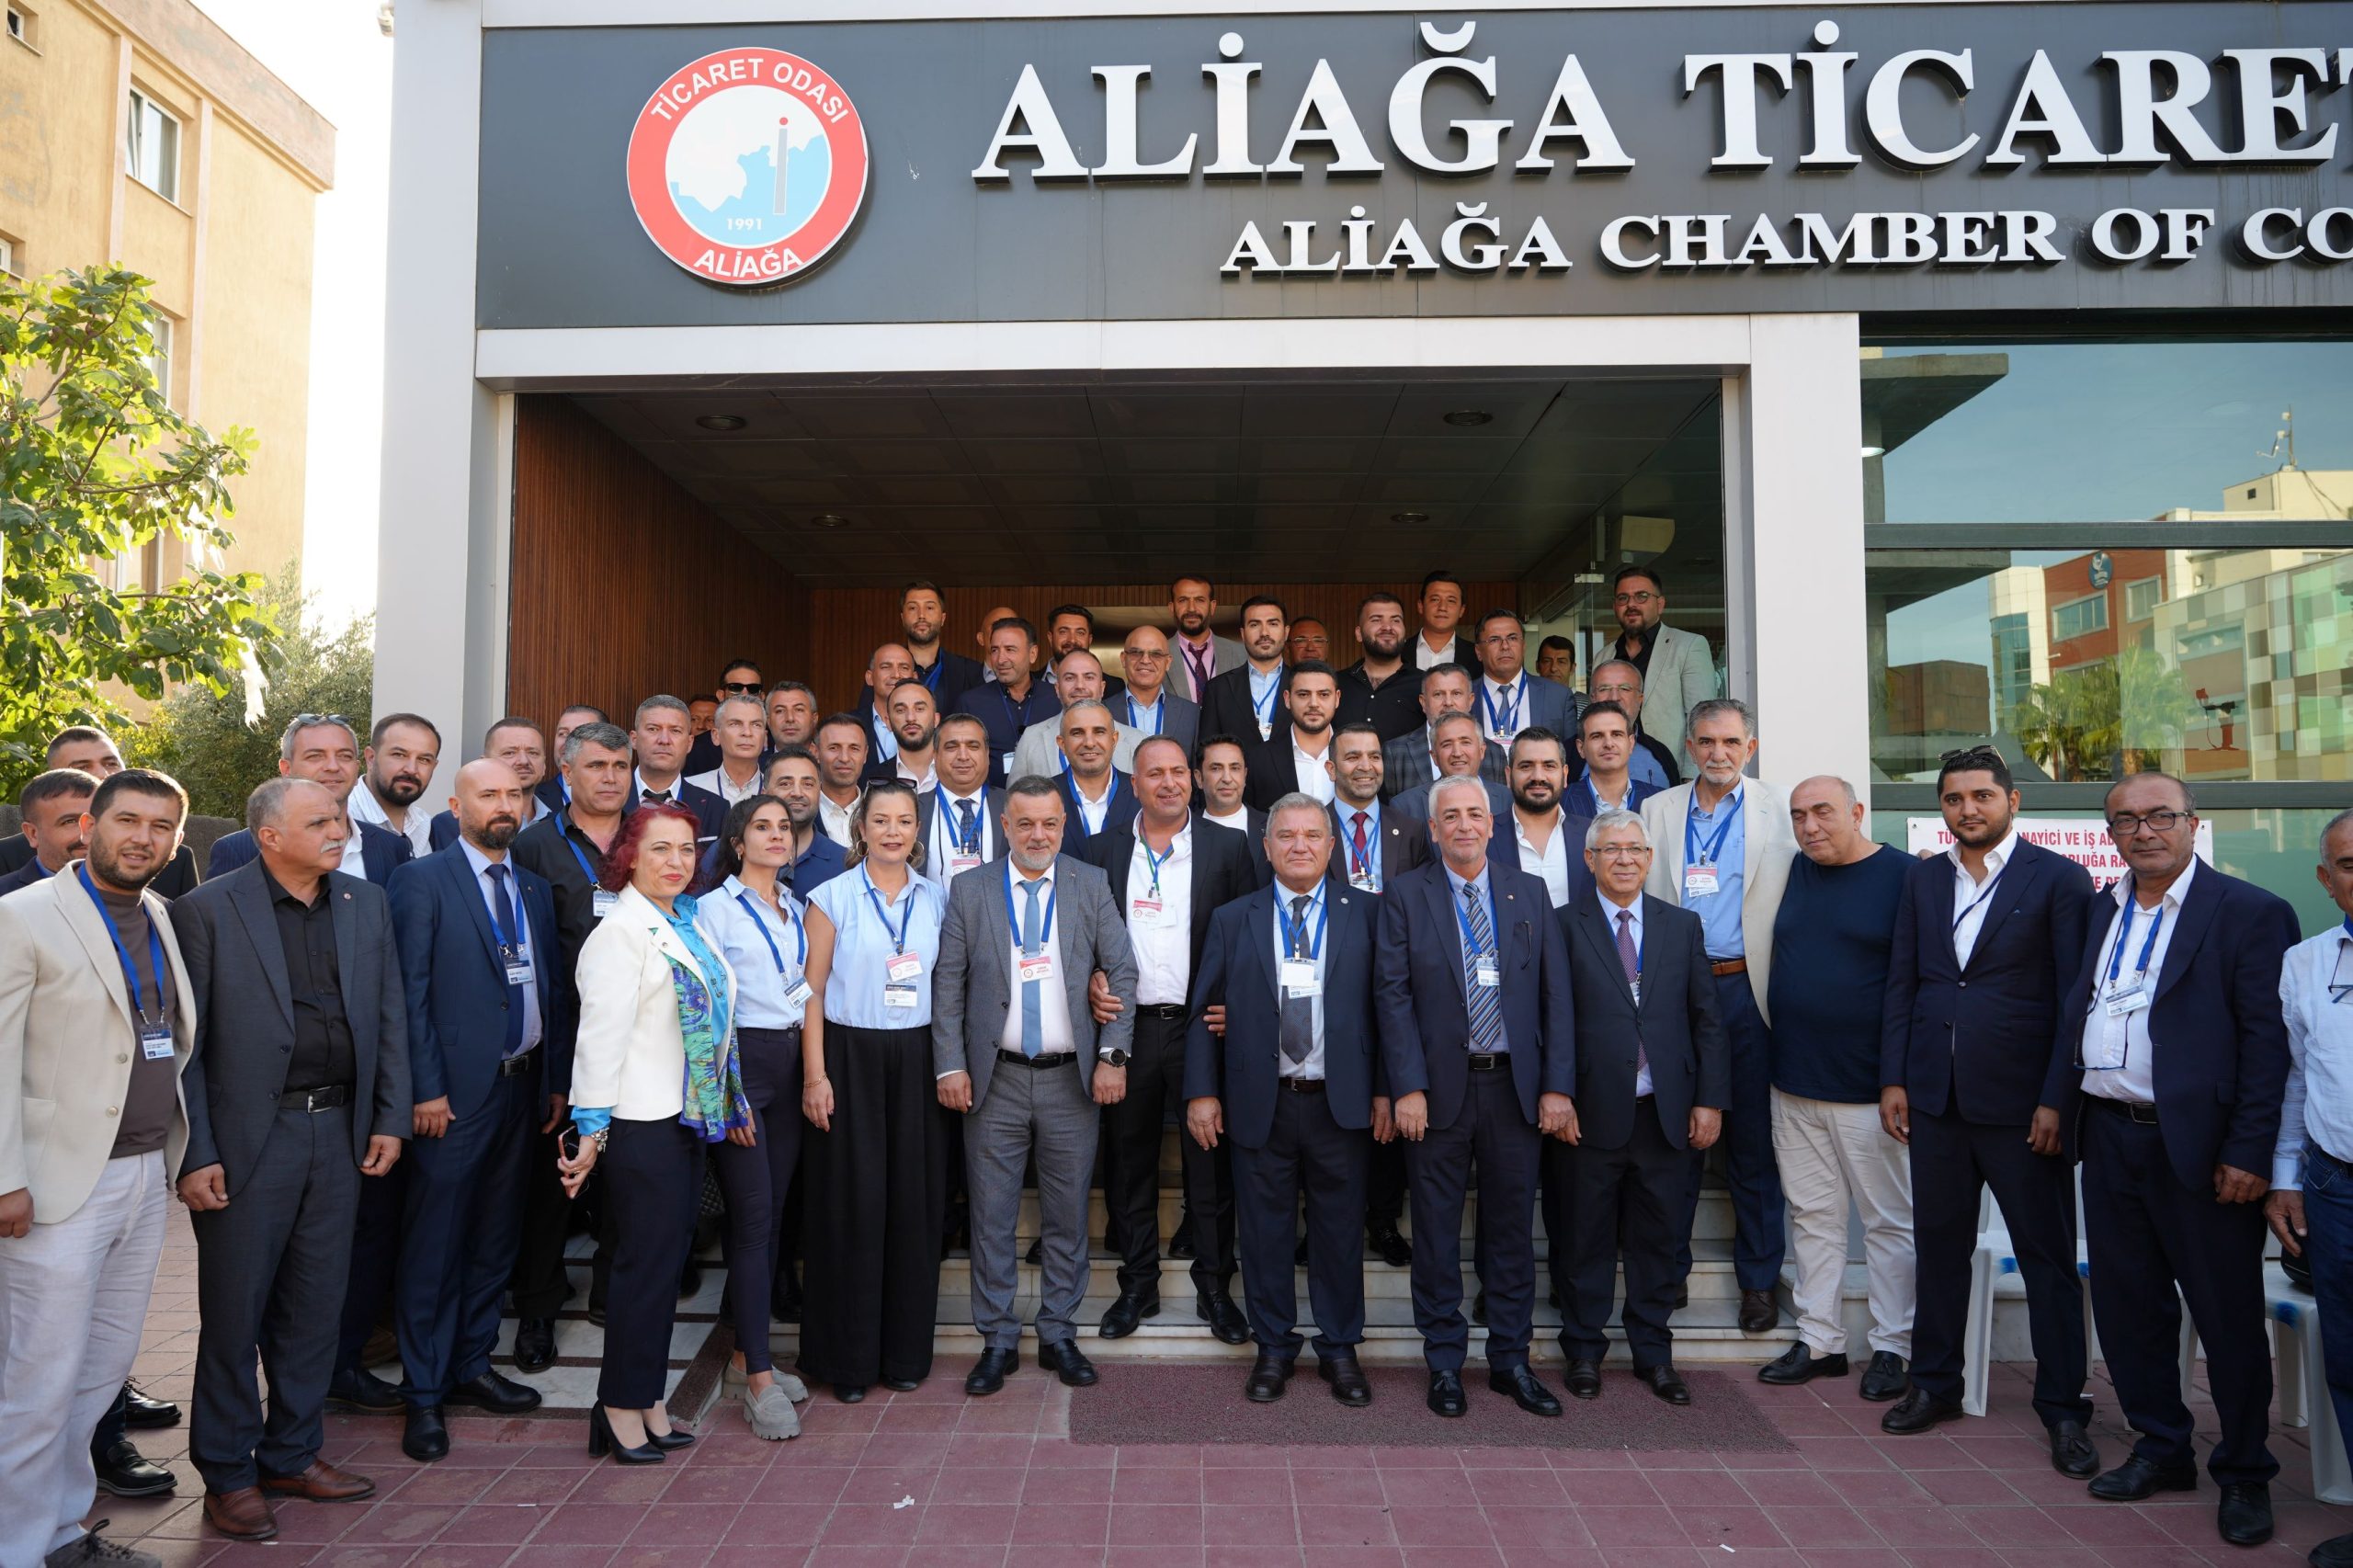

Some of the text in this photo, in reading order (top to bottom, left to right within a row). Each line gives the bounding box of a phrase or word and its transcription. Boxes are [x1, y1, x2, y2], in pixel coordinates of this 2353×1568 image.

[650, 58, 849, 124] TİCARET ODASI
[971, 19, 2353, 182] ALİAĞA TİCARE
[726, 218, 763, 231] 1991
[1219, 201, 1574, 275] ALİAĞA
[1598, 210, 2067, 270] CHAMBER
[2089, 207, 2216, 263] OF
[693, 246, 804, 278] ALİAĞA
[2064, 832, 2080, 846] VE
[2084, 829, 2096, 849] İŞ
